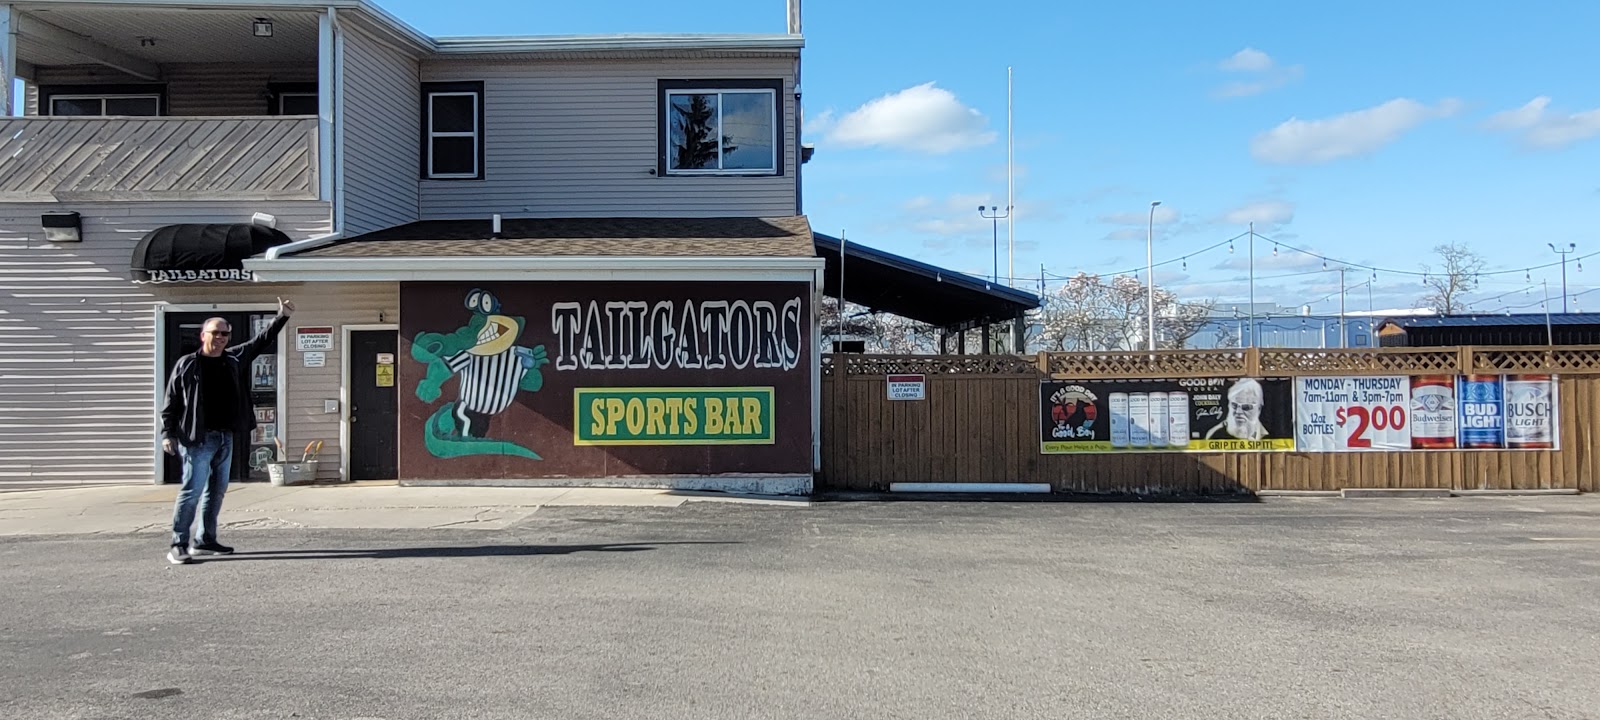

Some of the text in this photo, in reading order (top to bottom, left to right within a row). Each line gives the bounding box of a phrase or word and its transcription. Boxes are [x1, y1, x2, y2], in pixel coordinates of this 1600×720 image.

[147, 269, 253, 281] TAILGATORS
[552, 297, 801, 371] TAILGATORS
[1179, 378, 1207, 387] GOOD
[1305, 379, 1346, 390] MONDAY
[1353, 378, 1402, 390] THURSDAY
[1065, 385, 1085, 393] GOOD
[1303, 391, 1404, 405] 7am-11am & 3pm-7pm
[1464, 403, 1497, 416] BUD
[1508, 402, 1551, 417] BUSCH
[591, 397, 763, 436] SPORTS BAR
[1310, 413, 1326, 423] 12oz
[1412, 414, 1453, 423] Budweiser
[1461, 416, 1501, 428] LIGHT
[1052, 426, 1076, 438] Good
[1303, 424, 1334, 435] BOTTLES
[1208, 441, 1229, 449] GRIP
[1230, 441, 1237, 449] IT
[1239, 441, 1246, 449] &
[1247, 441, 1261, 449] SIP
